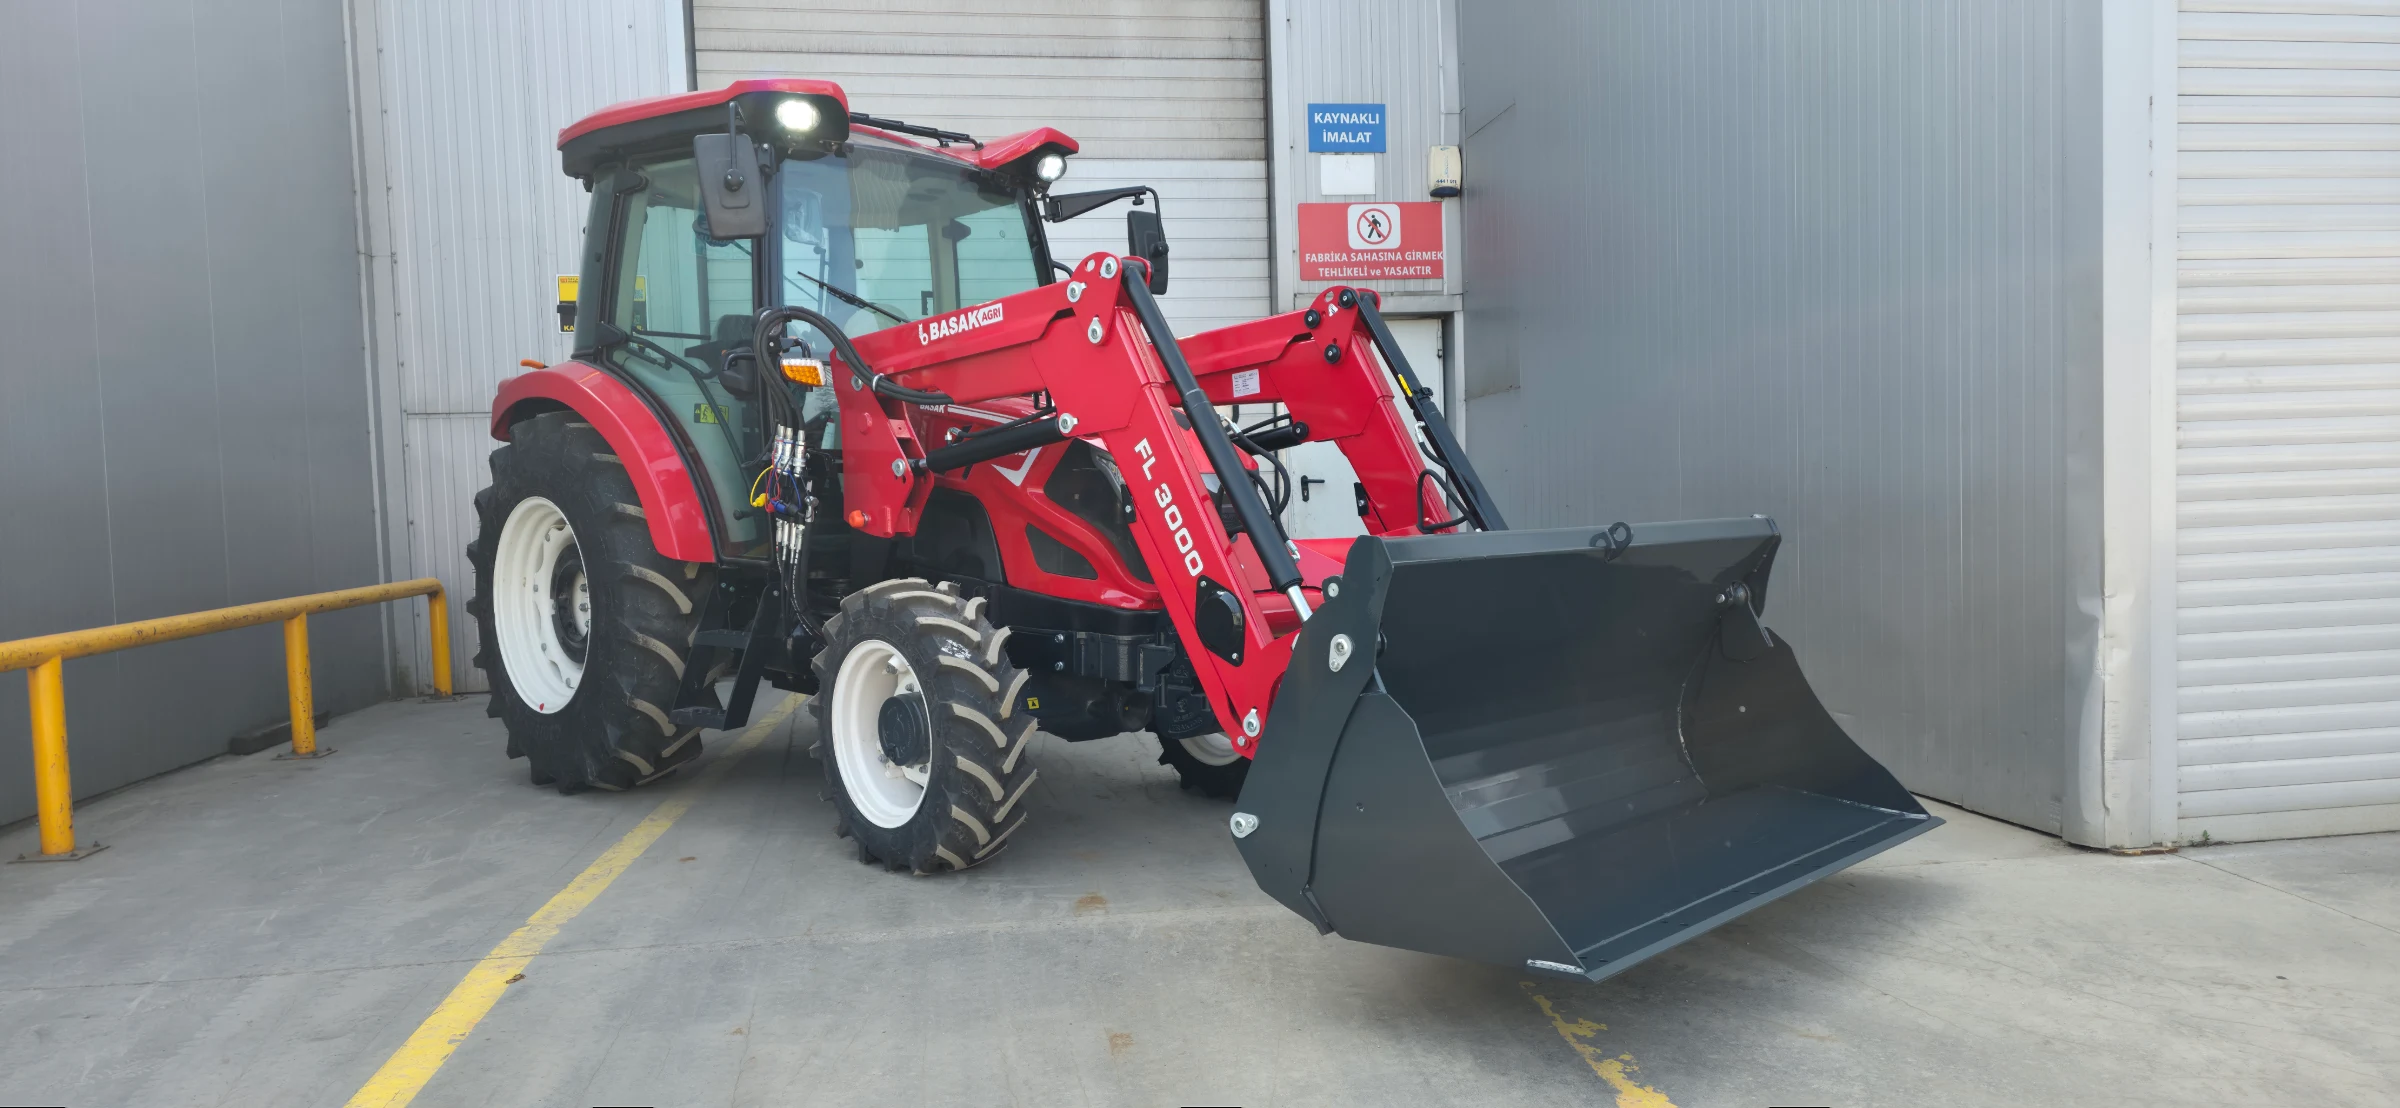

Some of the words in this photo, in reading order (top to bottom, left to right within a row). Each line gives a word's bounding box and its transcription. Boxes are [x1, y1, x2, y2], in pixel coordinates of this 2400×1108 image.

[1314, 112, 1380, 125] KAYNAKLI
[1322, 129, 1373, 143] İMALAT
[1305, 251, 1348, 263] FABRİKA
[1350, 251, 1403, 262] SAHASINA
[1405, 249, 1444, 261] GİRMEK
[1318, 265, 1368, 278] TEHLİKELİ
[1370, 268, 1382, 276] ve
[1384, 265, 1432, 277] YASAKTIR
[929, 309, 980, 341] BASAK
[981, 306, 1001, 323] AGRI
[1134, 437, 1156, 481] FL
[1154, 482, 1204, 577] 3000
